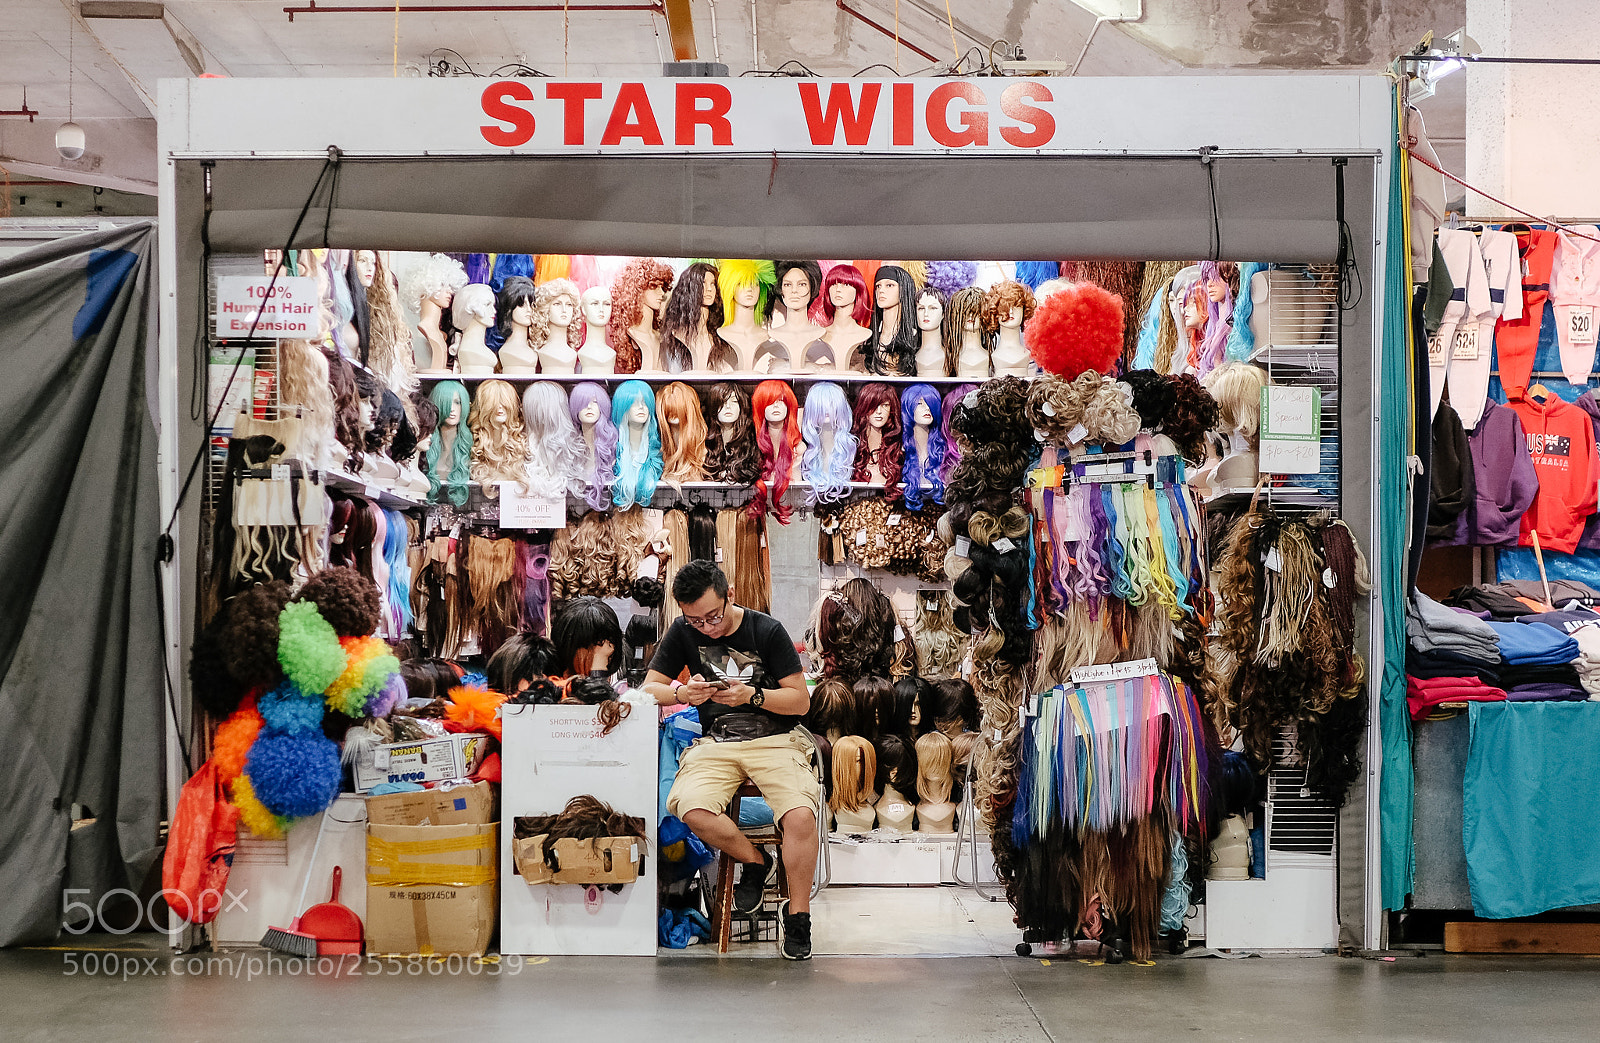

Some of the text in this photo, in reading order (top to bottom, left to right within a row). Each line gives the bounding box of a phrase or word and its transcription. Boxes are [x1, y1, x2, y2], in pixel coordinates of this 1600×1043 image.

[480, 81, 1056, 148] STAR WIGS
[246, 285, 292, 299] 100%
[223, 301, 314, 314] Human Hair
[230, 319, 306, 331] Exension
[1571, 315, 1590, 332] $20
[1428, 338, 1442, 354] 26
[1523, 433, 1543, 455] US
[549, 717, 606, 726] SHORT WIG $3
[551, 730, 605, 739] LONG WIG $40
[390, 745, 423, 757] BANAN
